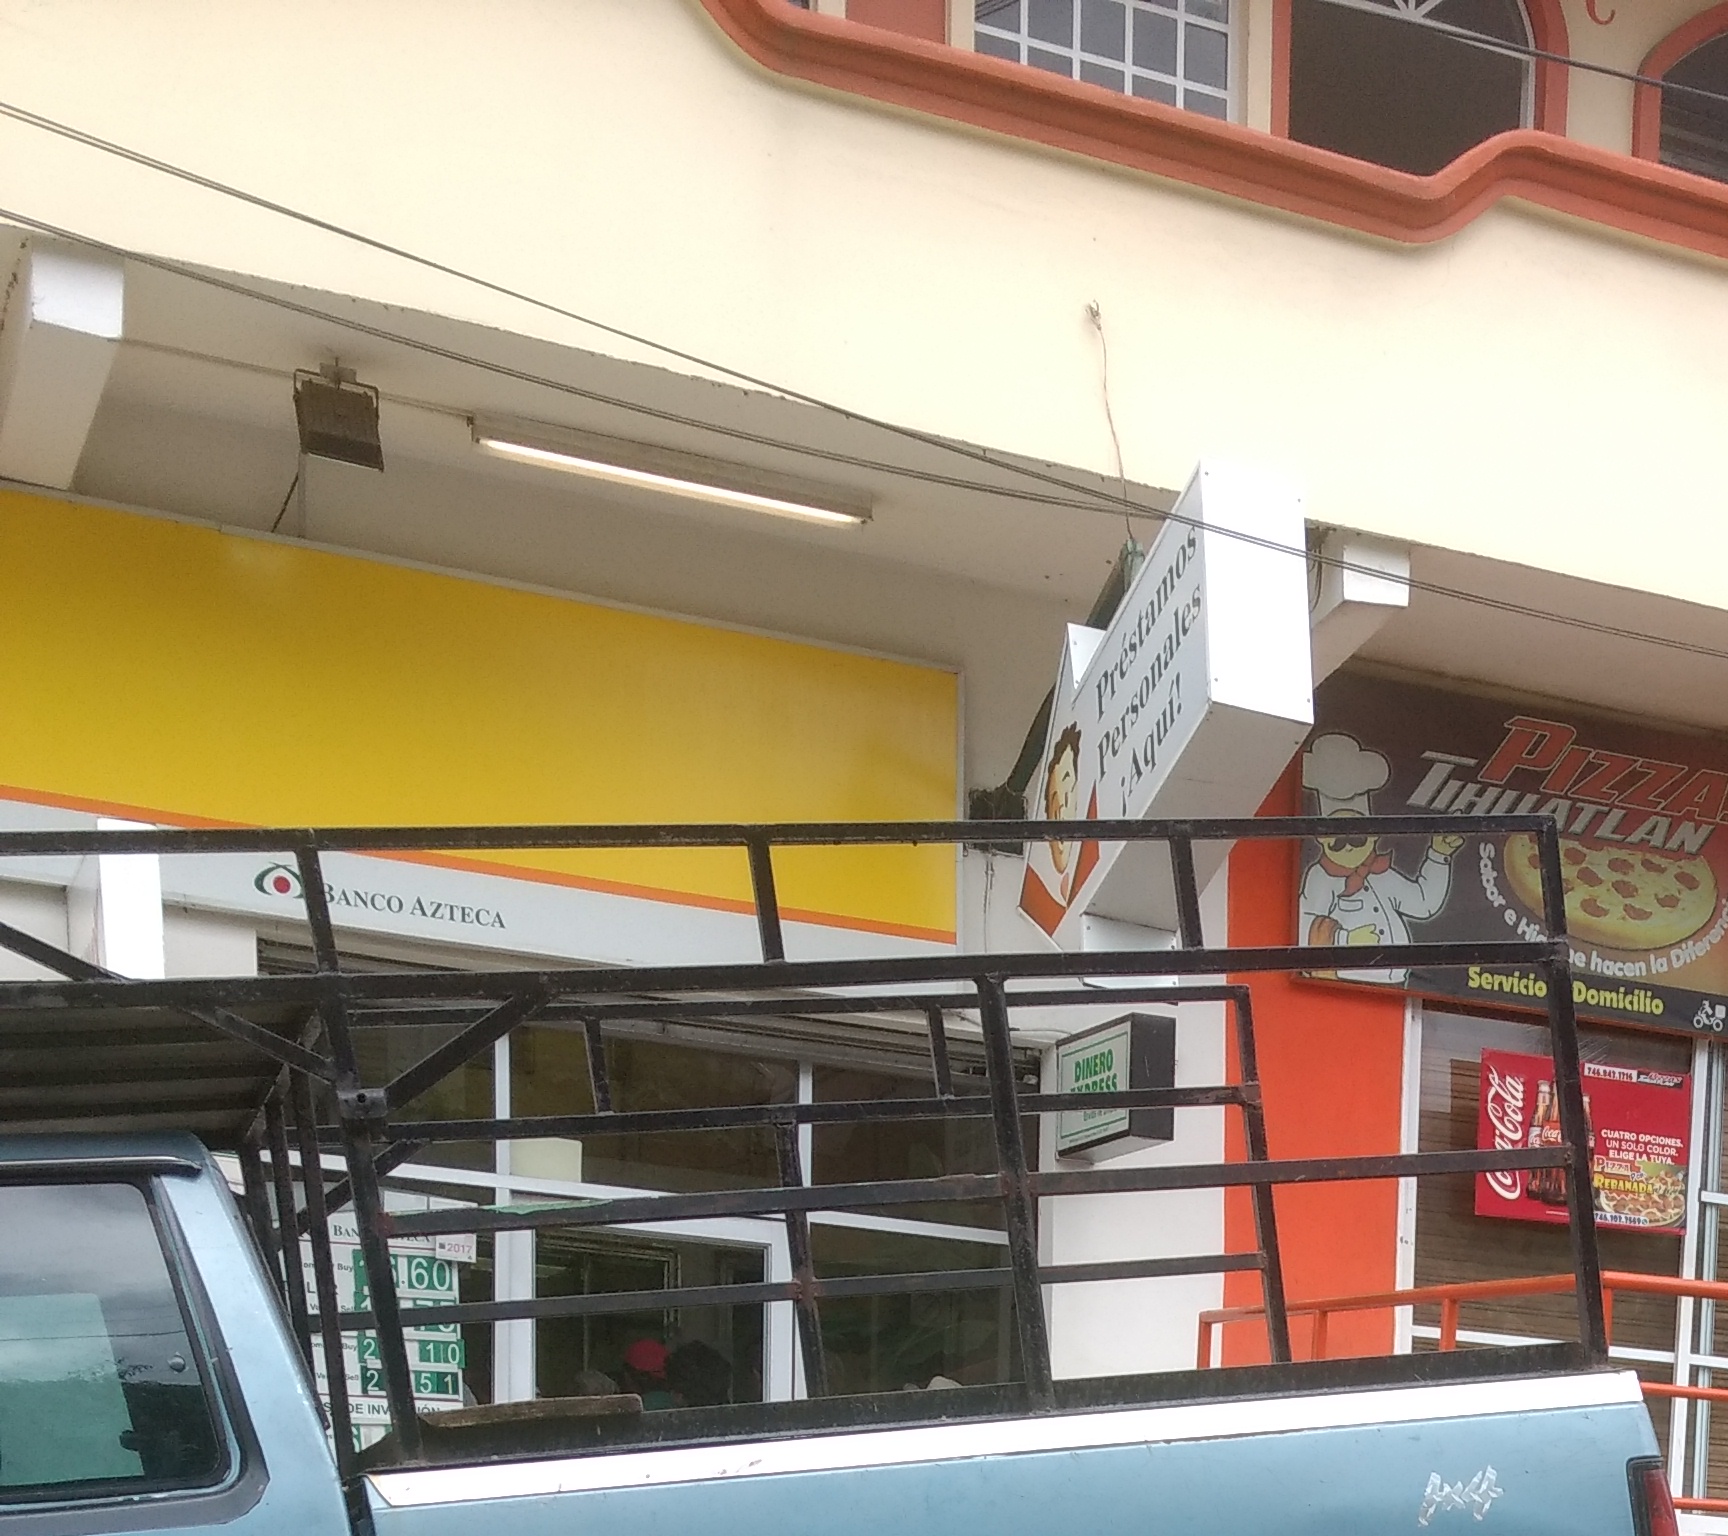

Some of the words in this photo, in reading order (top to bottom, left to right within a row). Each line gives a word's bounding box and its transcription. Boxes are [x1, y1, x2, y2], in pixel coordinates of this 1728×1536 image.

[1095, 524, 1197, 724] Préstamos
[1097, 583, 1202, 784] Personales
[1119, 671, 1183, 818] ¡Aquí!
[1405, 750, 1716, 854] TIHUATLAN
[409, 896, 507, 929] AZTECA
[1478, 842, 1507, 908] Sabor
[1503, 907, 1518, 926] e
[1590, 952, 1648, 978] hacen
[1650, 953, 1669, 975] la
[1467, 965, 1548, 998] Servicio
[1571, 979, 1665, 1016] Domicilio
[1074, 1048, 1114, 1083] DINERO
[1600, 1128, 1637, 1141] CUATRO
[1638, 1133, 1684, 1148] OPCIONES.
[1605, 1138, 1619, 1149] UN
[1621, 1141, 1645, 1152] SOLO
[1646, 1145, 1679, 1157] COLOR.
[1608, 1149, 1635, 1161] ELIGE
[1636, 1152, 1648, 1162] LA
[1649, 1154, 1676, 1166] TUYA.
[446, 1242, 473, 1254] 2017
